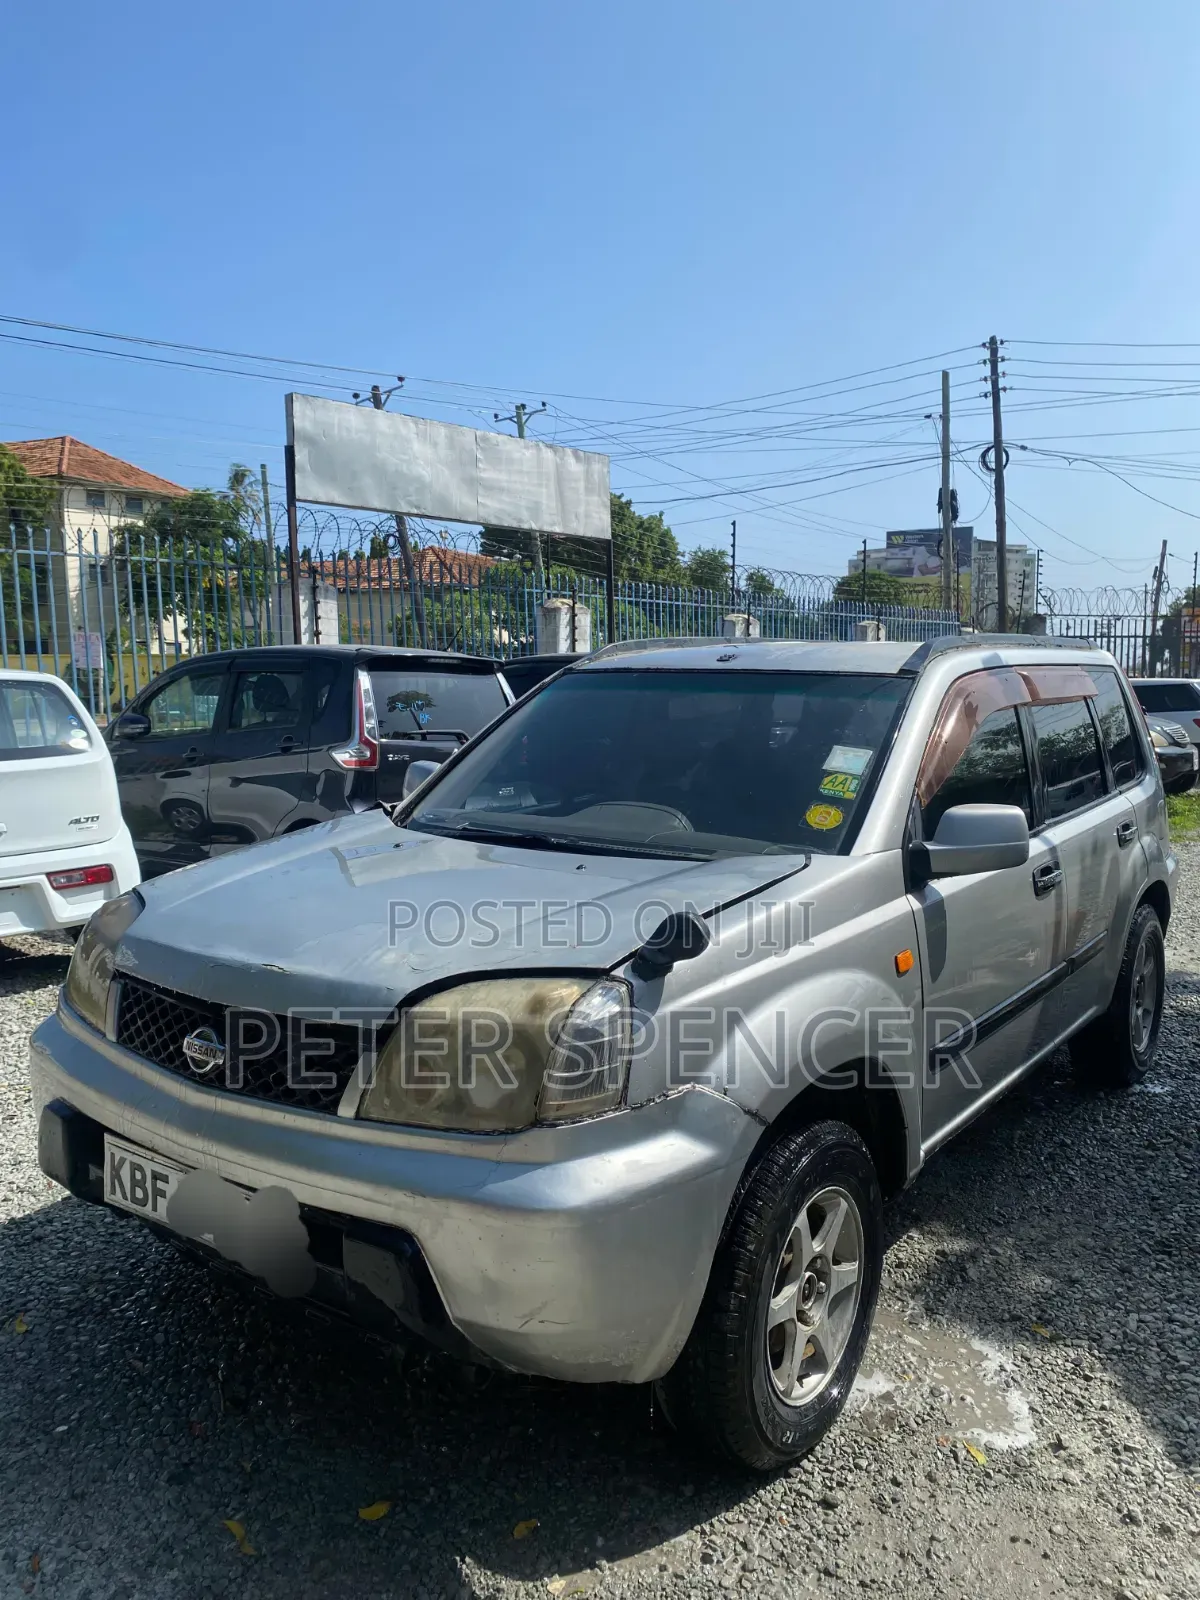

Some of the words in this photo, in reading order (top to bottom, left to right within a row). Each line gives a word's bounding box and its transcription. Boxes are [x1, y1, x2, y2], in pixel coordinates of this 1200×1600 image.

[823, 775, 847, 789] AA
[820, 788, 844, 797] KENYA
[68, 815, 100, 826] ALTO
[185, 1041, 217, 1059] NISSAN
[109, 1152, 170, 1213] KBF
